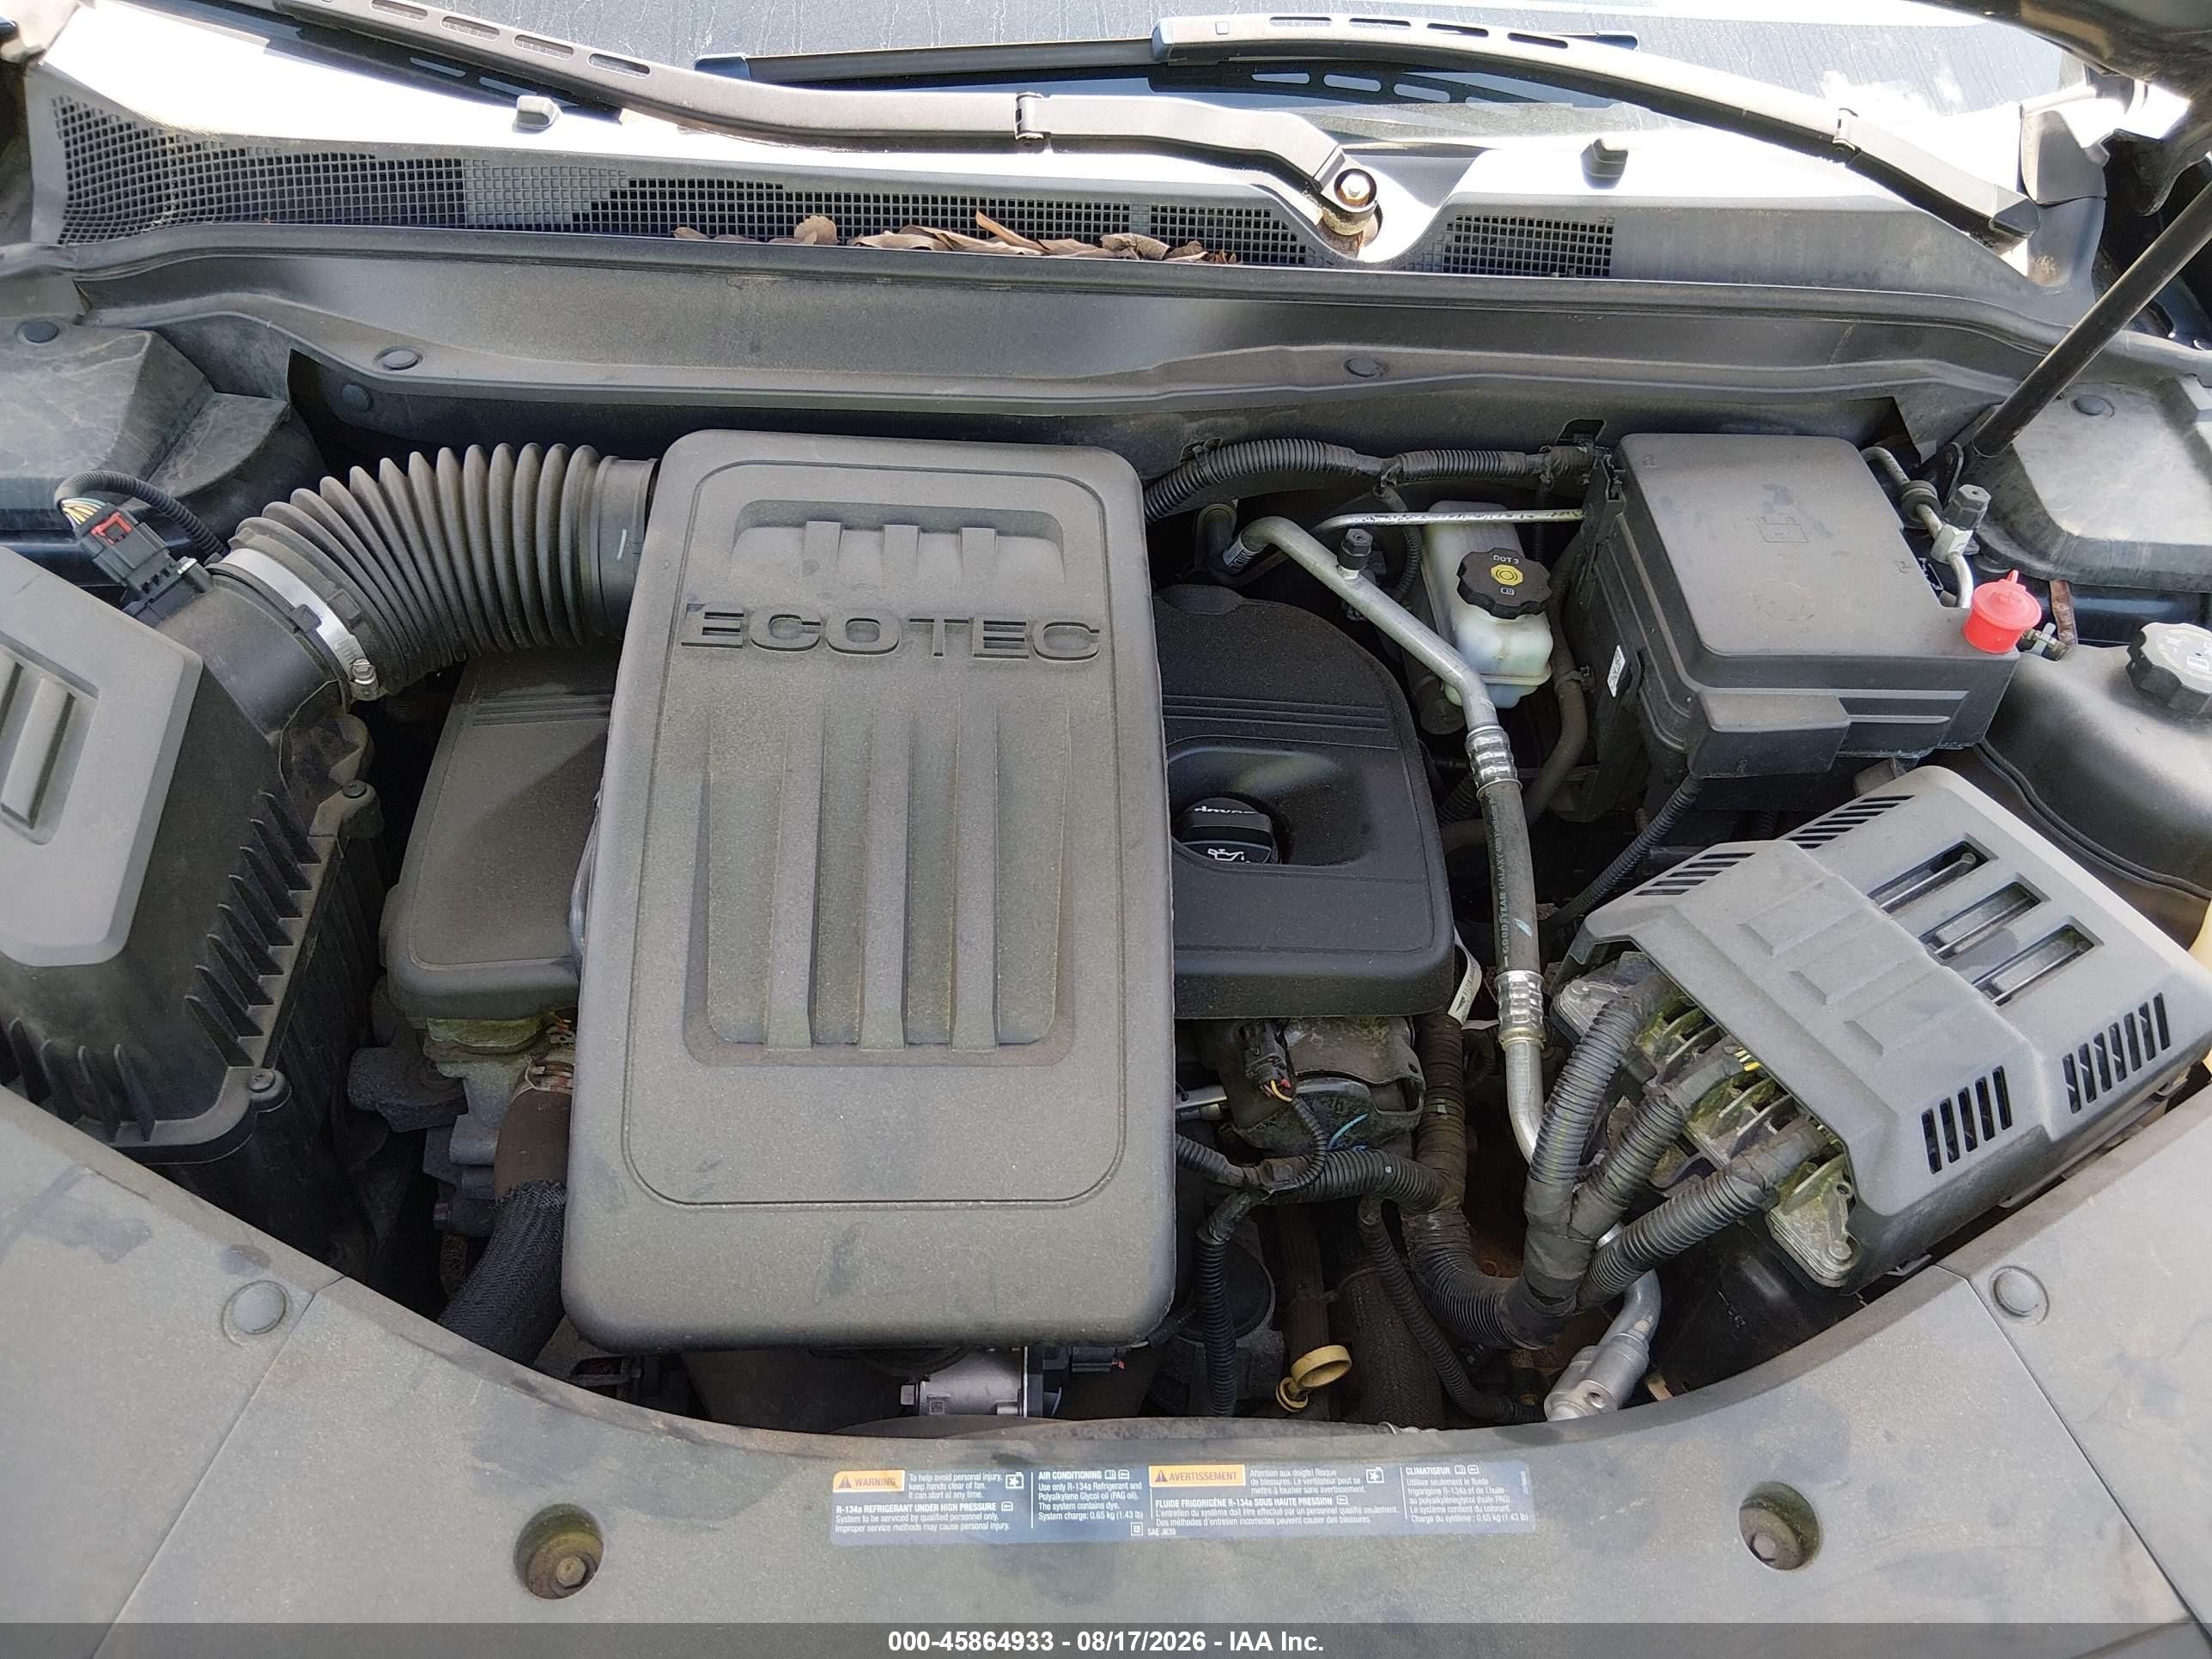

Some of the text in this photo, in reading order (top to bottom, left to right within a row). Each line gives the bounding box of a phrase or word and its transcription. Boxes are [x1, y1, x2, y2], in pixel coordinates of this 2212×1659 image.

[1493, 554, 1511, 563] DOT
[681, 602, 1100, 661] ECOTEC
[1497, 852, 1510, 954] GOODYEAR GALAXY
[1038, 1471, 1102, 1480] AIR CONDITIONING
[1315, 1468, 1337, 1477] Risque
[1405, 1467, 1451, 1475] CLIMATISEUR
[918, 1474, 933, 1483] help
[934, 1474, 952, 1482] avoid
[953, 1473, 981, 1483] personal
[1169, 1471, 1237, 1482] AVERTISSEMENT
[1303, 1477, 1336, 1485] ventilateur
[1337, 1477, 1352, 1486] peut
[854, 1477, 896, 1487] WARNING
[909, 1482, 986, 1492] keep hands clear of fan.
[1038, 1482, 1142, 1492] Use only R-134a Refrigerant and
[1251, 1487, 1272, 1495] mettre
[1279, 1486, 1303, 1494] tourner
[1443, 1487, 1467, 1495] R-134a
[1038, 1492, 1079, 1502] Polyalkylene
[1080, 1492, 1100, 1501] Glycol
[1110, 1491, 1126, 1501] (PAG
[1039, 1501, 1120, 1512] The system contains dye.
[1155, 1496, 1333, 1508] FLUIDE FRIGORIGÈNE R-134a SOUS HAUTE PRESSION
[836, 1502, 997, 1513] R-134a REFRIGERANT UNDER HIGH PRESSURE
[1156, 1509, 1190, 1517] L'entretien
[1191, 1509, 1199, 1517] du
[1229, 1507, 1242, 1516] doit
[1284, 1507, 1295, 1516] par
[1306, 1506, 1337, 1516] personnel
[836, 1515, 861, 1525] System
[871, 1514, 880, 1522] be
[880, 1513, 909, 1522] serviced
[910, 1513, 918, 1523] by
[920, 1513, 948, 1523] qualified
[950, 1513, 982, 1522] personnel
[983, 1512, 1000, 1521] only.
[1038, 1510, 1143, 1522] System charge: 0.65 kg (1.43 lb)
[1411, 1515, 1434, 1525] Charge
[1435, 1515, 1443, 1523] du
[1156, 1518, 1169, 1527] Des
[1203, 1517, 1238, 1526] d'entretien
[1239, 1517, 1275, 1526] incorrectes
[1276, 1516, 1302, 1525] peuvent
[835, 1524, 866, 1534] Improper
[867, 1524, 891, 1532] service
[893, 1523, 922, 1532] methods
[923, 1524, 938, 1533] may
[960, 1522, 989, 1531] personal
[990, 1522, 1011, 1531] injury.
[1147, 1528, 1176, 1536] SAE J639
